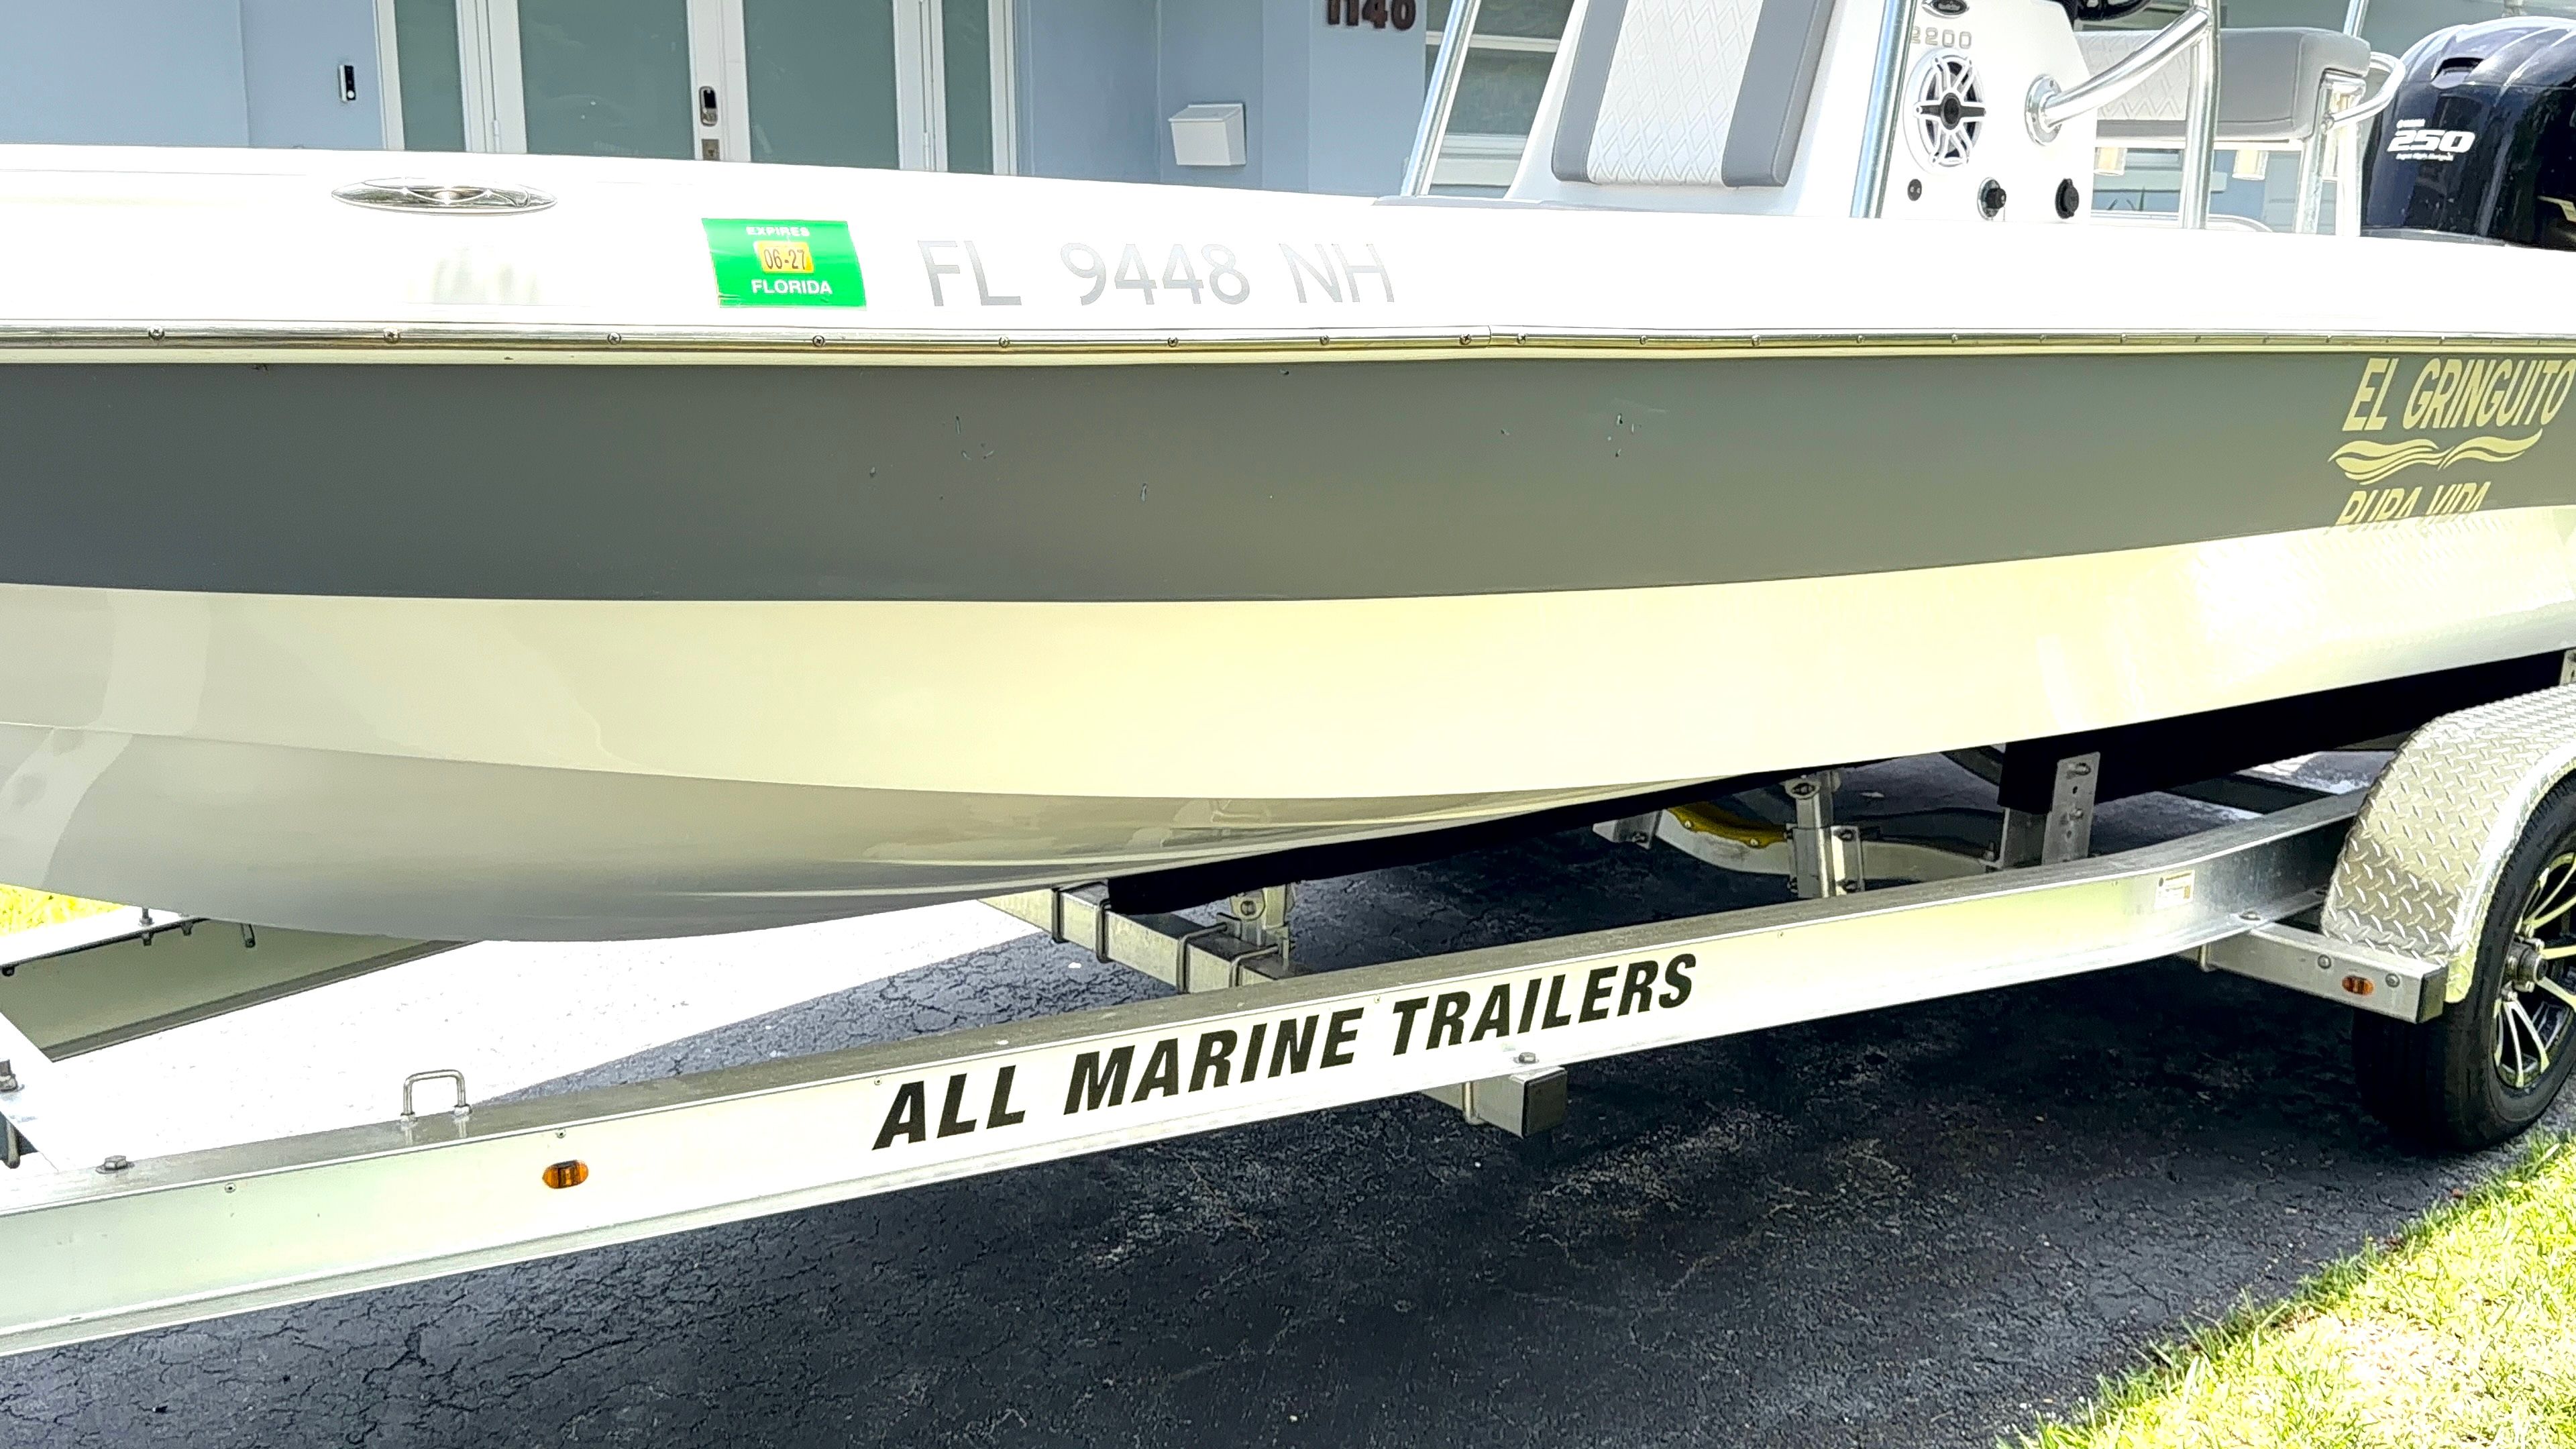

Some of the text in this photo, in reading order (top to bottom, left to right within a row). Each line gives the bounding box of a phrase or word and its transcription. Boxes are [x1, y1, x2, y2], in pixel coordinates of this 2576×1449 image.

[1328, 0, 1417, 31] 1140
[2387, 129, 2476, 153] 250
[746, 226, 810, 237] EXPIRES
[763, 248, 806, 270] 06-27
[751, 279, 833, 294] FLORIDA
[917, 240, 1395, 307] FL 9448 NH
[2341, 357, 2576, 431] EL GRINGUITO
[872, 953, 1697, 1151] ALL MARINE TRAILERS
